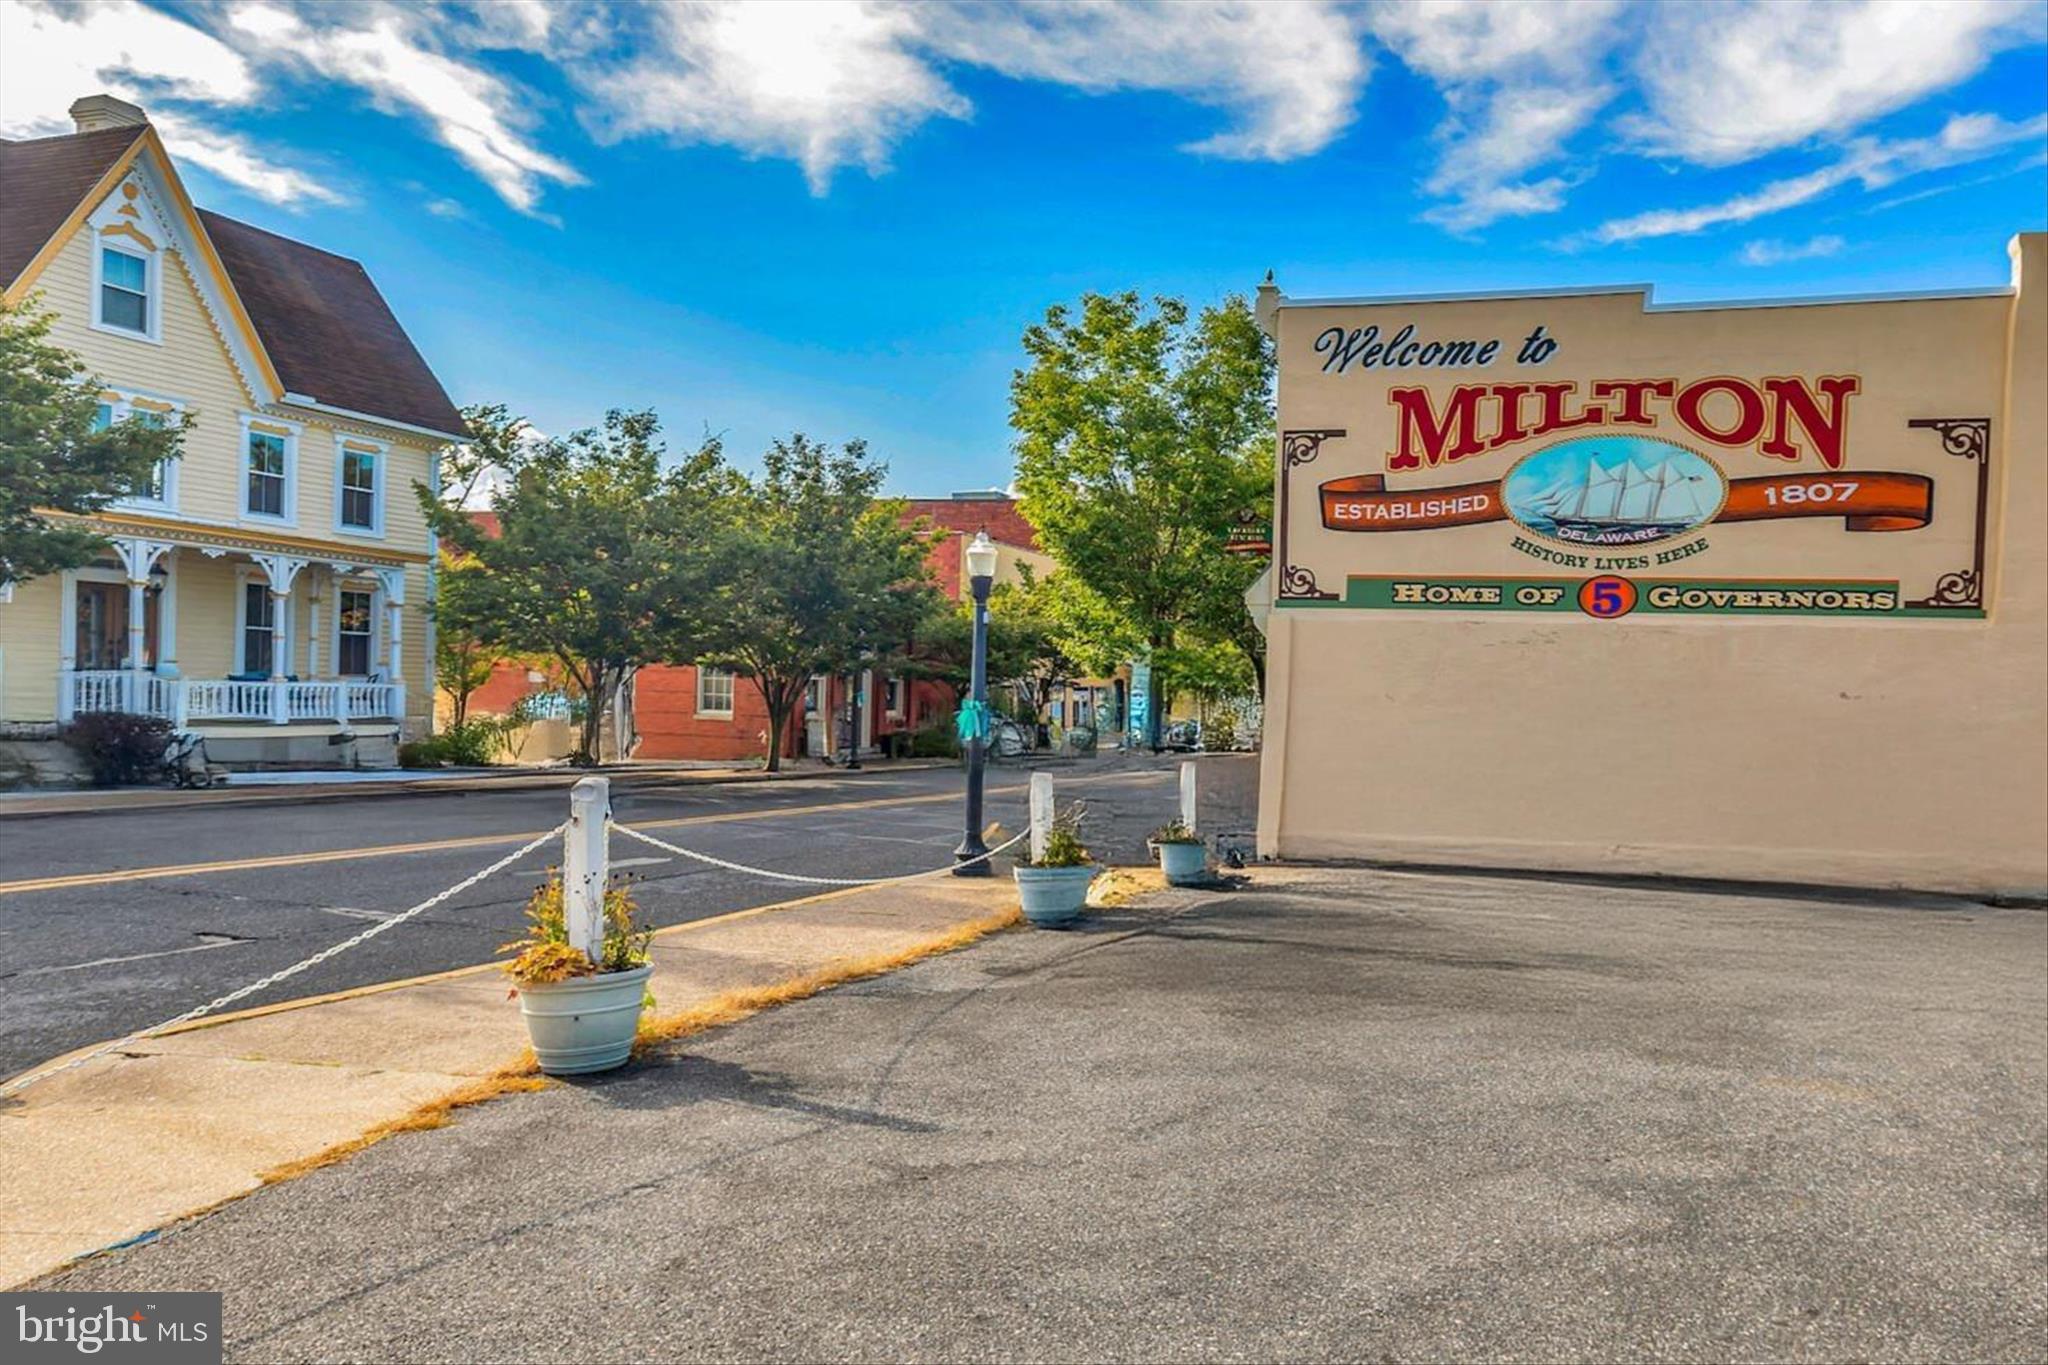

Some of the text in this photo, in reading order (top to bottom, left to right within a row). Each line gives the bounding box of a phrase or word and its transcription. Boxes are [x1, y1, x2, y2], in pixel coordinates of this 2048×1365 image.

[1314, 324, 1560, 375] Welcome to
[1387, 376, 1861, 471] MILTON
[1334, 482, 1859, 520] ESTABLISHED 1807
[1510, 536, 1709, 570] HISTORY LIVES HERE
[1557, 527, 1662, 543] DELAWARE
[1392, 582, 1897, 615] HOME OF 5 GOVERNORS
